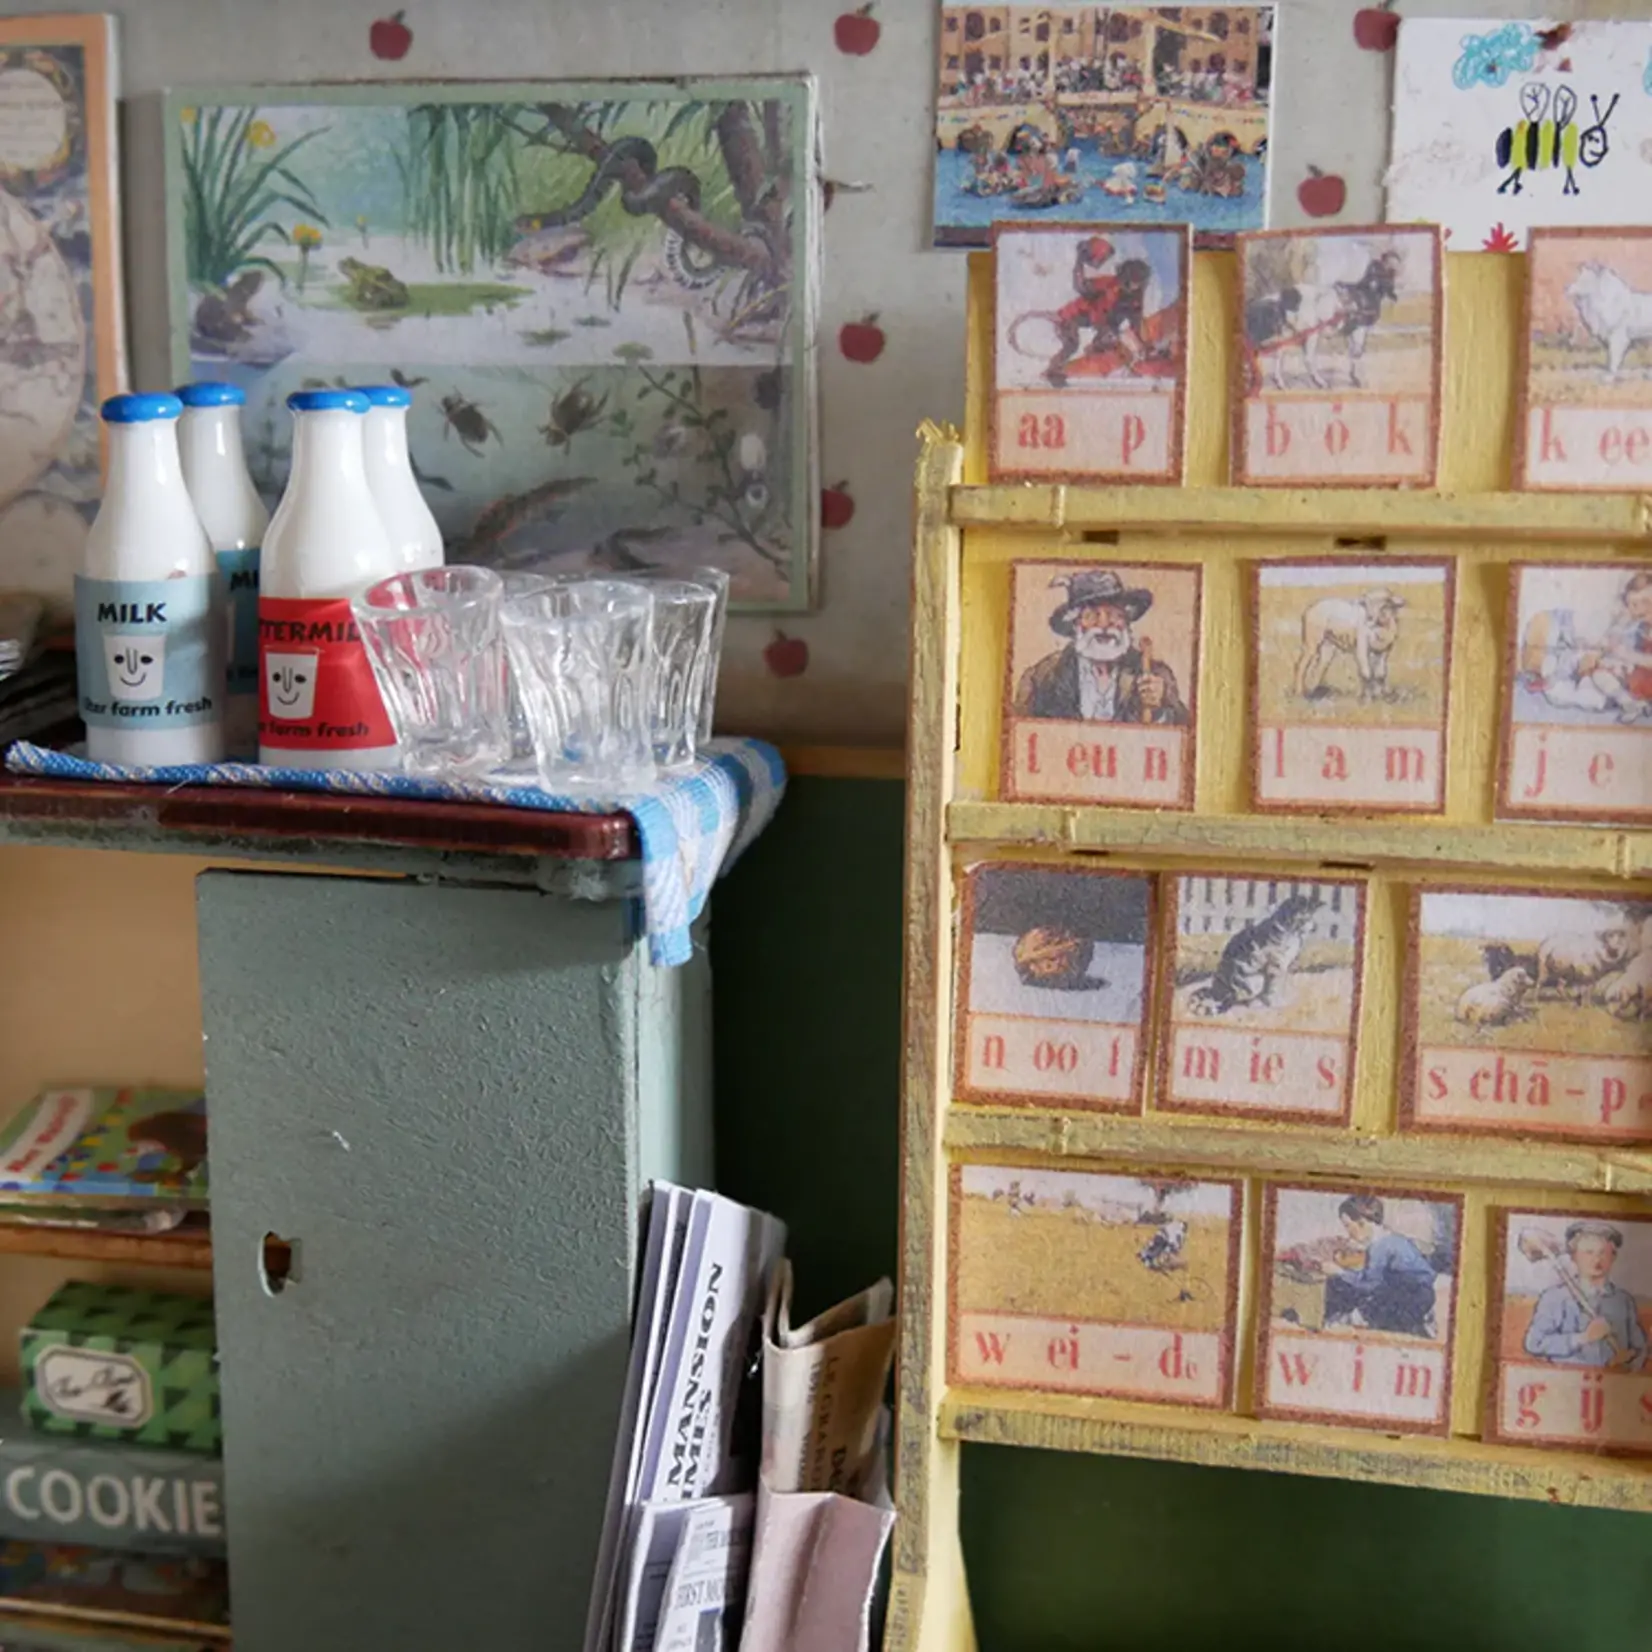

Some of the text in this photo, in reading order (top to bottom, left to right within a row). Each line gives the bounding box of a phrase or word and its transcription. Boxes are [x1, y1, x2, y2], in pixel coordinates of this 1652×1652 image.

[97, 603, 167, 625] MILK
[111, 701, 160, 718] farm
[165, 697, 213, 716] fresh
[270, 721, 313, 738] farm
[317, 722, 370, 739] fresh
[667, 1262, 724, 1487] MANSION
[5, 1466, 221, 1535] COOKIE
